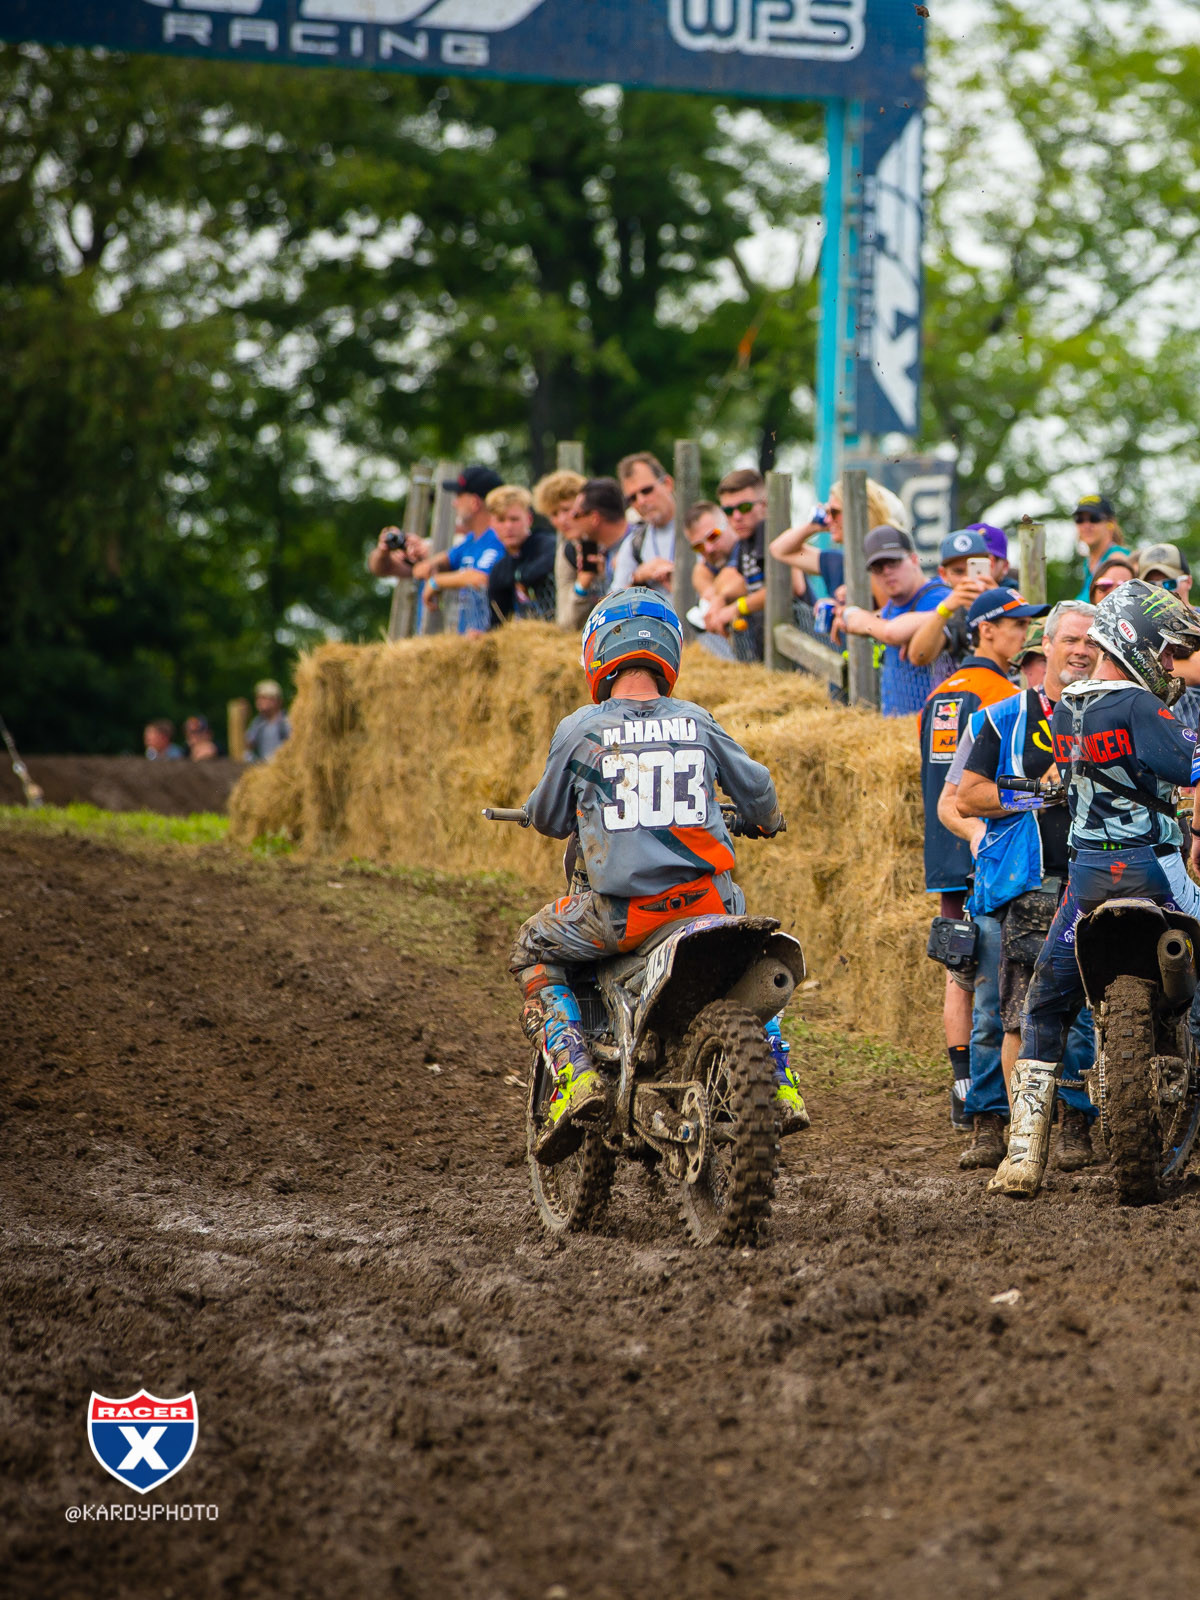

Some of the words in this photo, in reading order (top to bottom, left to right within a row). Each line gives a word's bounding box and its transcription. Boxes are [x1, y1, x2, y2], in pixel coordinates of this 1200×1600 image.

[162, 14, 491, 67] RACING
[1120, 622, 1135, 640] BELL
[601, 749, 708, 831] 303
